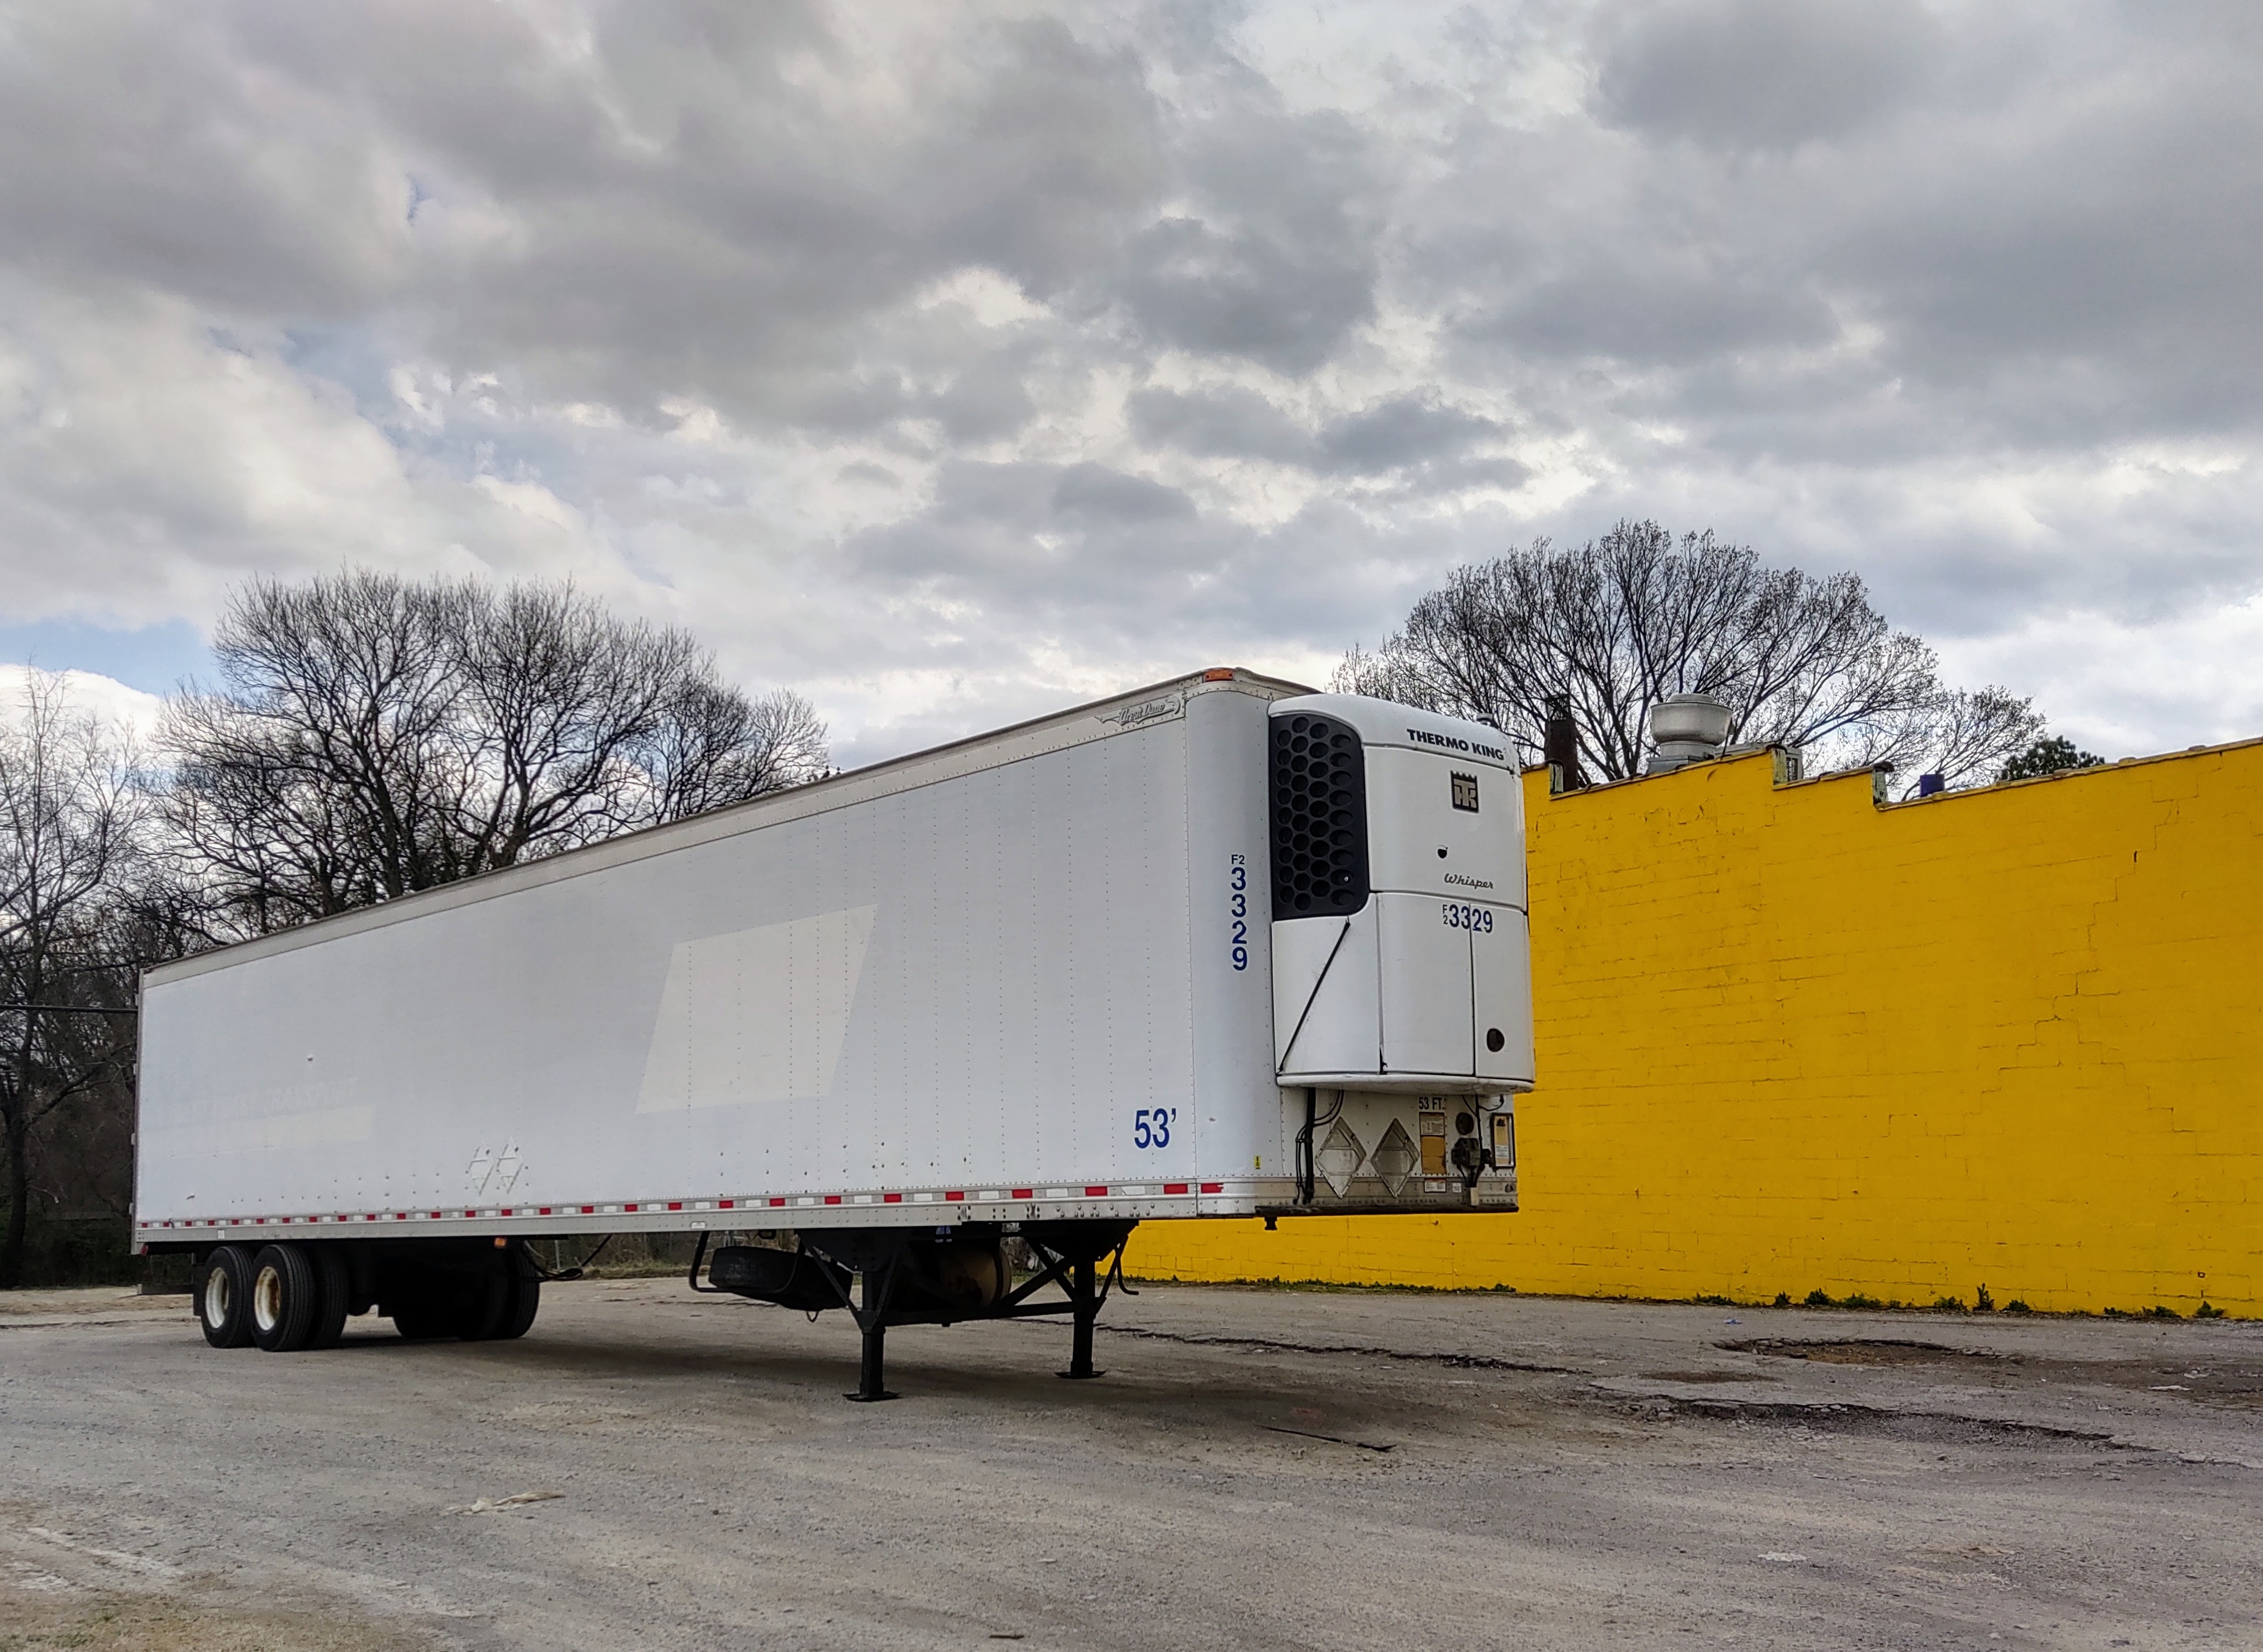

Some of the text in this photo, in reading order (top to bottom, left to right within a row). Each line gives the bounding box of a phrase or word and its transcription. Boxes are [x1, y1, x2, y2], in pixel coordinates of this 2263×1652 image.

[1144, 702, 1165, 716] Dane
[1406, 729, 1504, 760] THERMO KING
[1231, 854, 1245, 865] F2
[1444, 873, 1494, 889] Whisper
[1231, 867, 1247, 971] 3329
[1449, 904, 1493, 934] 3329
[1418, 1097, 1444, 1110] 53 FT.
